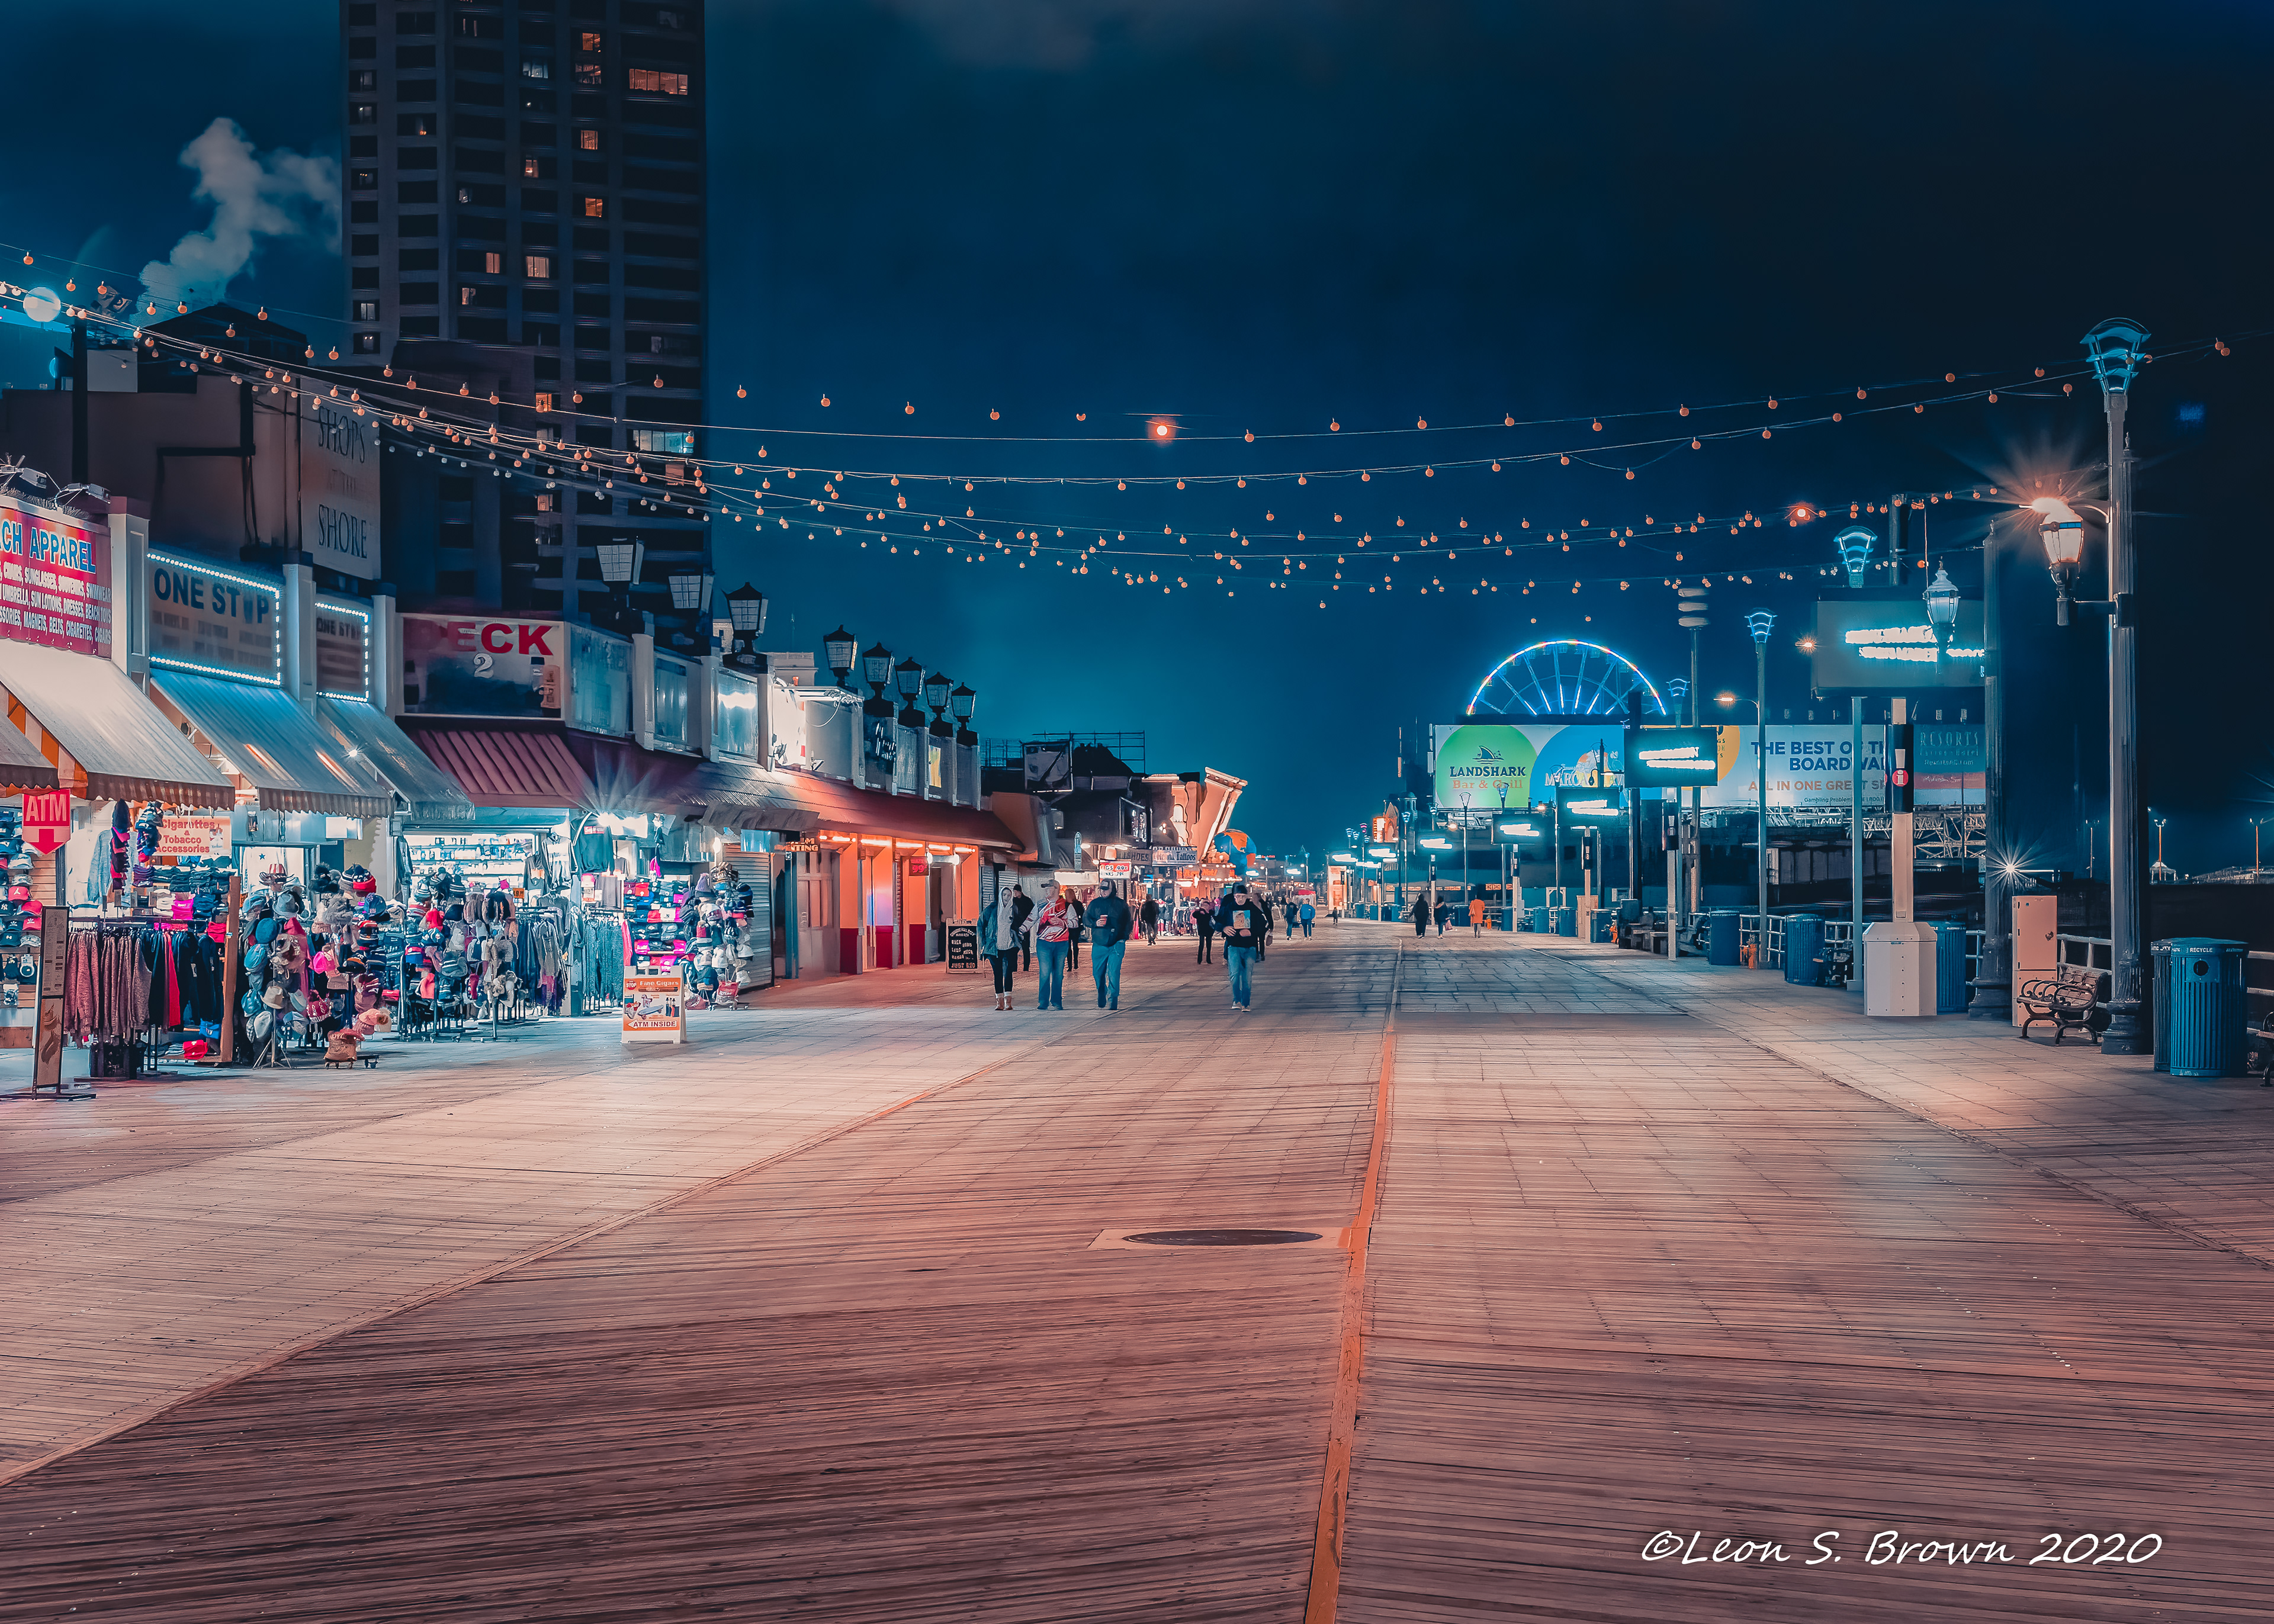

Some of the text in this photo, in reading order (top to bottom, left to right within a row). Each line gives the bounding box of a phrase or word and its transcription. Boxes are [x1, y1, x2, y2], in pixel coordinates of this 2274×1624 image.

[318, 406, 365, 464] SHOPS
[318, 504, 367, 559] SHORE
[0, 519, 23, 556] CH
[29, 526, 96, 574] APPAREL
[154, 568, 204, 610] ONE
[24, 610, 47, 636] MAGNETS,
[49, 616, 65, 639] BELTS,
[66, 620, 94, 644] CIGARETTES,
[474, 653, 494, 678] 2
[1920, 731, 1978, 746] RESORTS
[1751, 741, 1785, 755] THE
[1791, 741, 1835, 755] BEST
[1449, 766, 1527, 778] LANDSHARK
[1453, 779, 1523, 789] Bar & Gill
[1748, 781, 1773, 791] AL
[1777, 781, 1790, 791] IN
[1794, 781, 1822, 791] ONE
[1826, 780, 1868, 791] GRET
[25, 794, 67, 822] ATM
[163, 835, 201, 844] Tobacco
[156, 845, 210, 853] Accessories
[1176, 851, 1196, 861] Tattoos
